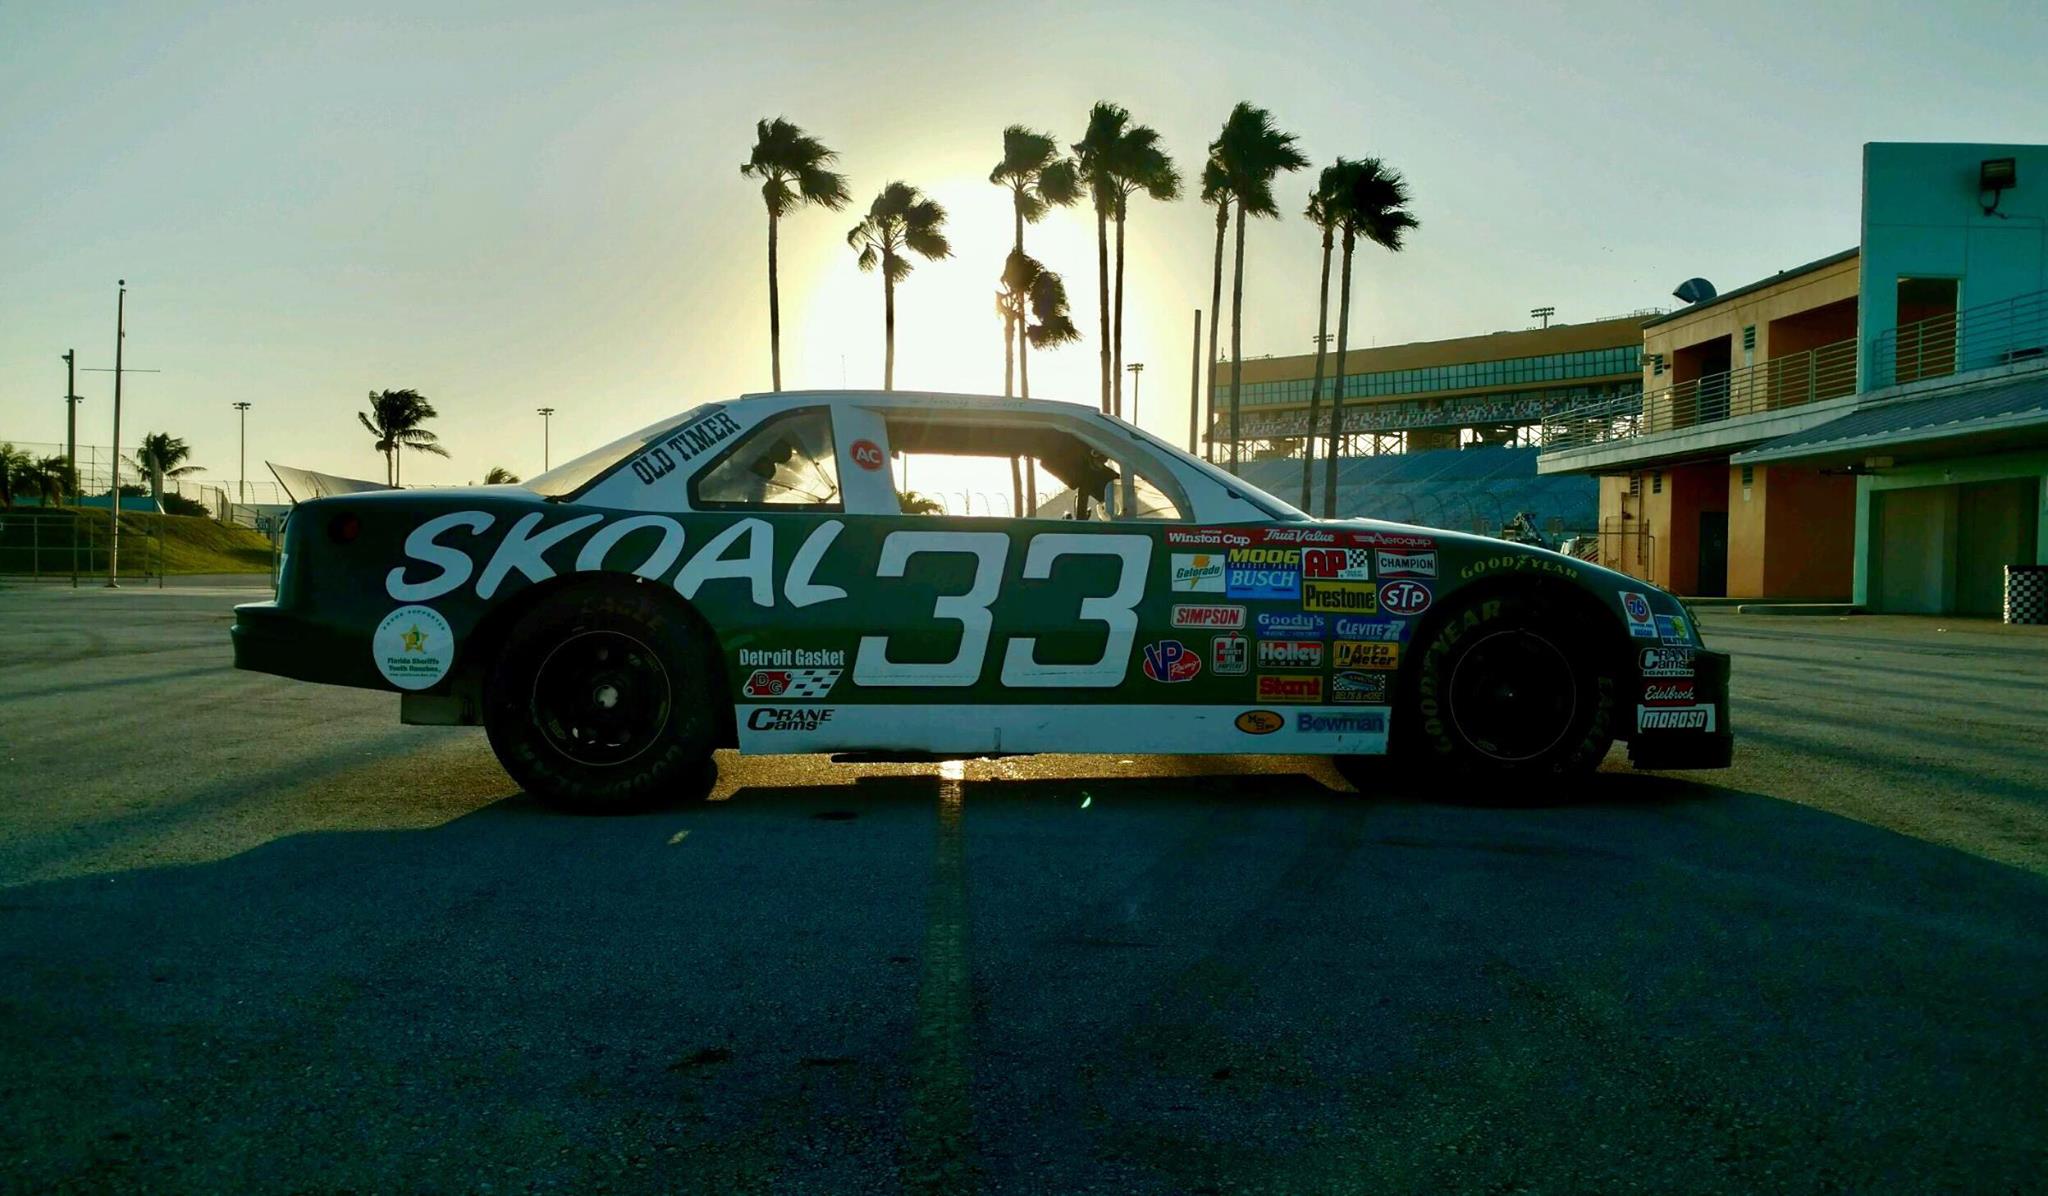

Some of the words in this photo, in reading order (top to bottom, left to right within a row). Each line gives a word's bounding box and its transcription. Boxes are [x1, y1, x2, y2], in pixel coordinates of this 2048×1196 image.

[631, 448, 676, 485] OLD
[669, 412, 742, 462] TIMER
[854, 447, 881, 464] AC
[1169, 532, 1221, 544] Winston
[1223, 533, 1251, 546] Cup
[1263, 528, 1297, 541] True
[1297, 529, 1335, 543] Value
[1372, 532, 1432, 547] Aeroquip
[385, 511, 848, 609] SKOAL
[1228, 549, 1300, 564] MOOG
[1305, 549, 1347, 578] AP
[1380, 557, 1433, 569] CHAMPION
[1231, 571, 1296, 587] BUSCH
[1306, 584, 1375, 609] Prestone
[1386, 584, 1425, 609] STP
[852, 531, 1153, 688] 33
[1177, 608, 1239, 624] SIMPSON
[1627, 599, 1646, 616] 76
[1258, 613, 1325, 631] Goody's
[1336, 618, 1383, 636] CLEVITE
[740, 648, 792, 666] Detroit
[795, 648, 845, 666] Gasket
[1259, 641, 1321, 666] Holley
[1355, 644, 1389, 655] Auto
[1144, 639, 1184, 683] VP
[1351, 655, 1395, 666] Meter
[1260, 676, 1319, 696] Stant
[1644, 684, 1695, 700] Edelbrock
[1299, 714, 1384, 731] Bowman
[1642, 711, 1706, 729] MOROSO
